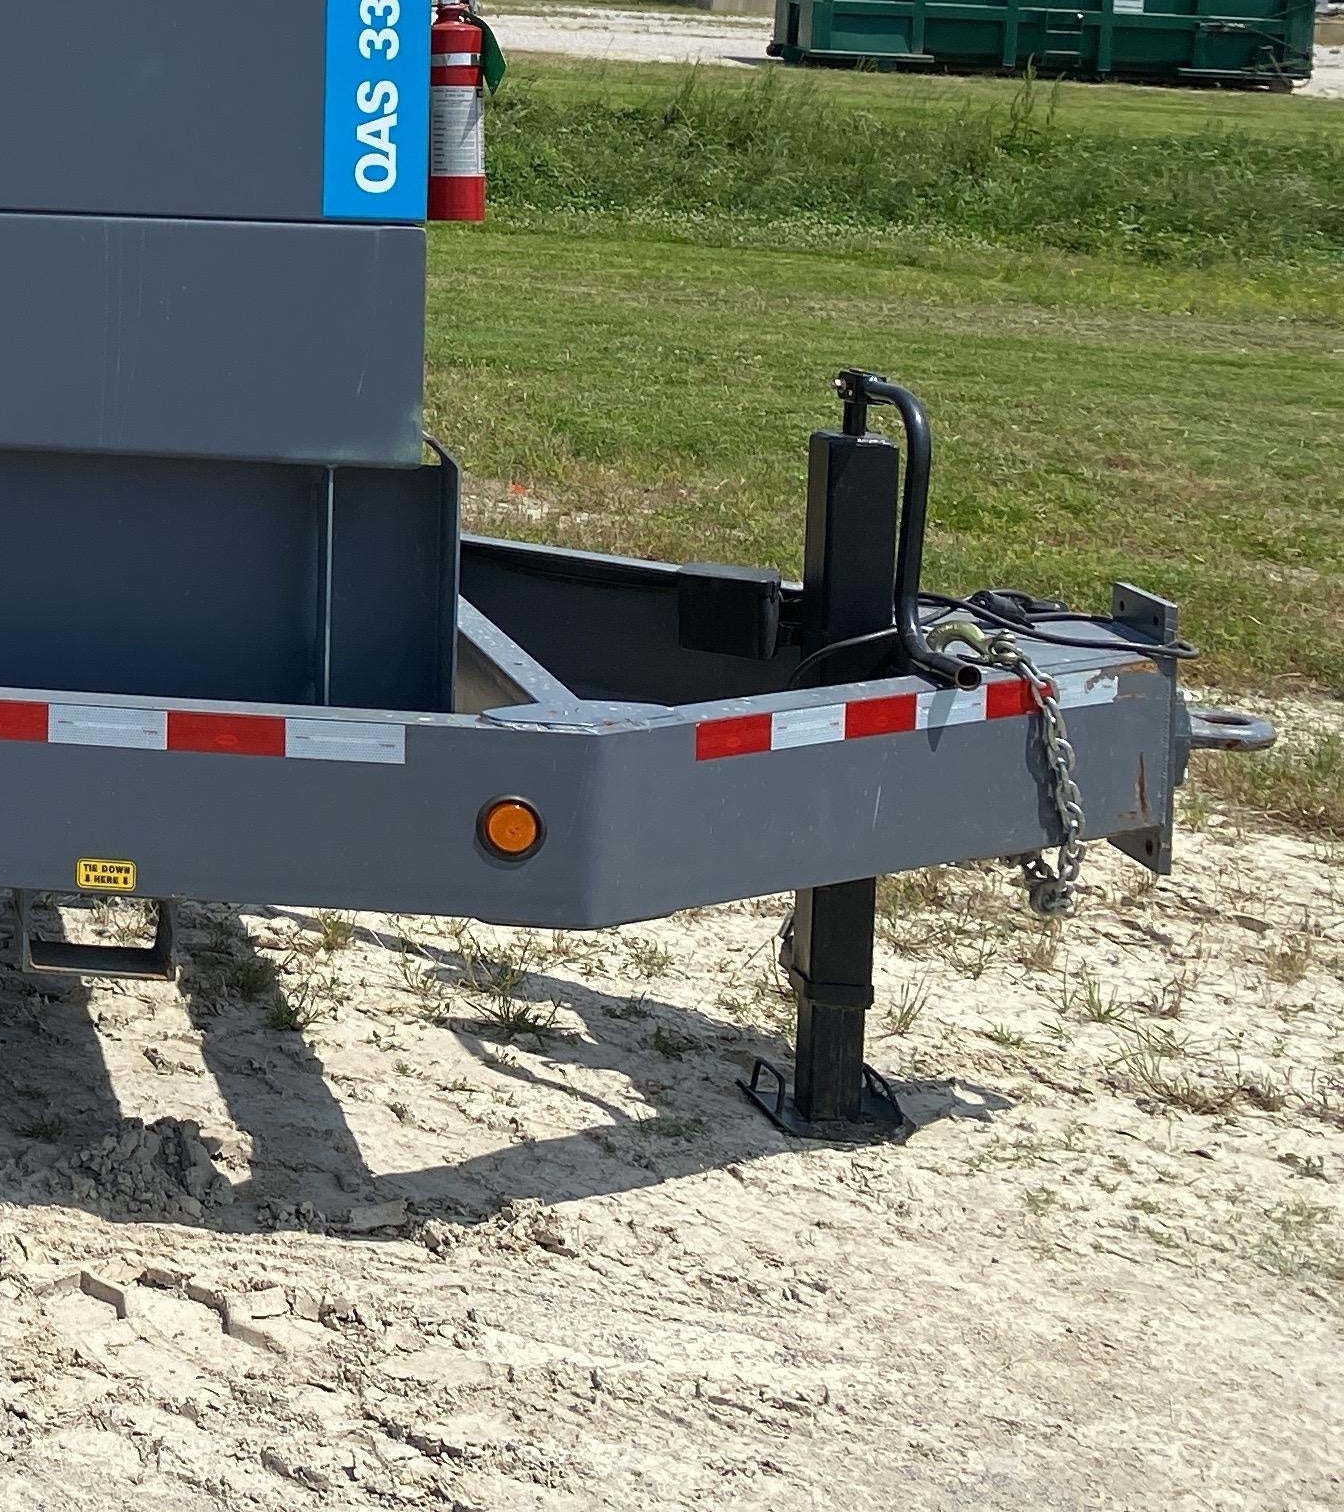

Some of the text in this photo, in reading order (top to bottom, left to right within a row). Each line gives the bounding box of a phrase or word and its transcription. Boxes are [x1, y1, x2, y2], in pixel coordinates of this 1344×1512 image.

[354, 80, 399, 194] QAS
[83, 864, 131, 875] TIE DOWN
[94, 875, 119, 885] HERE
